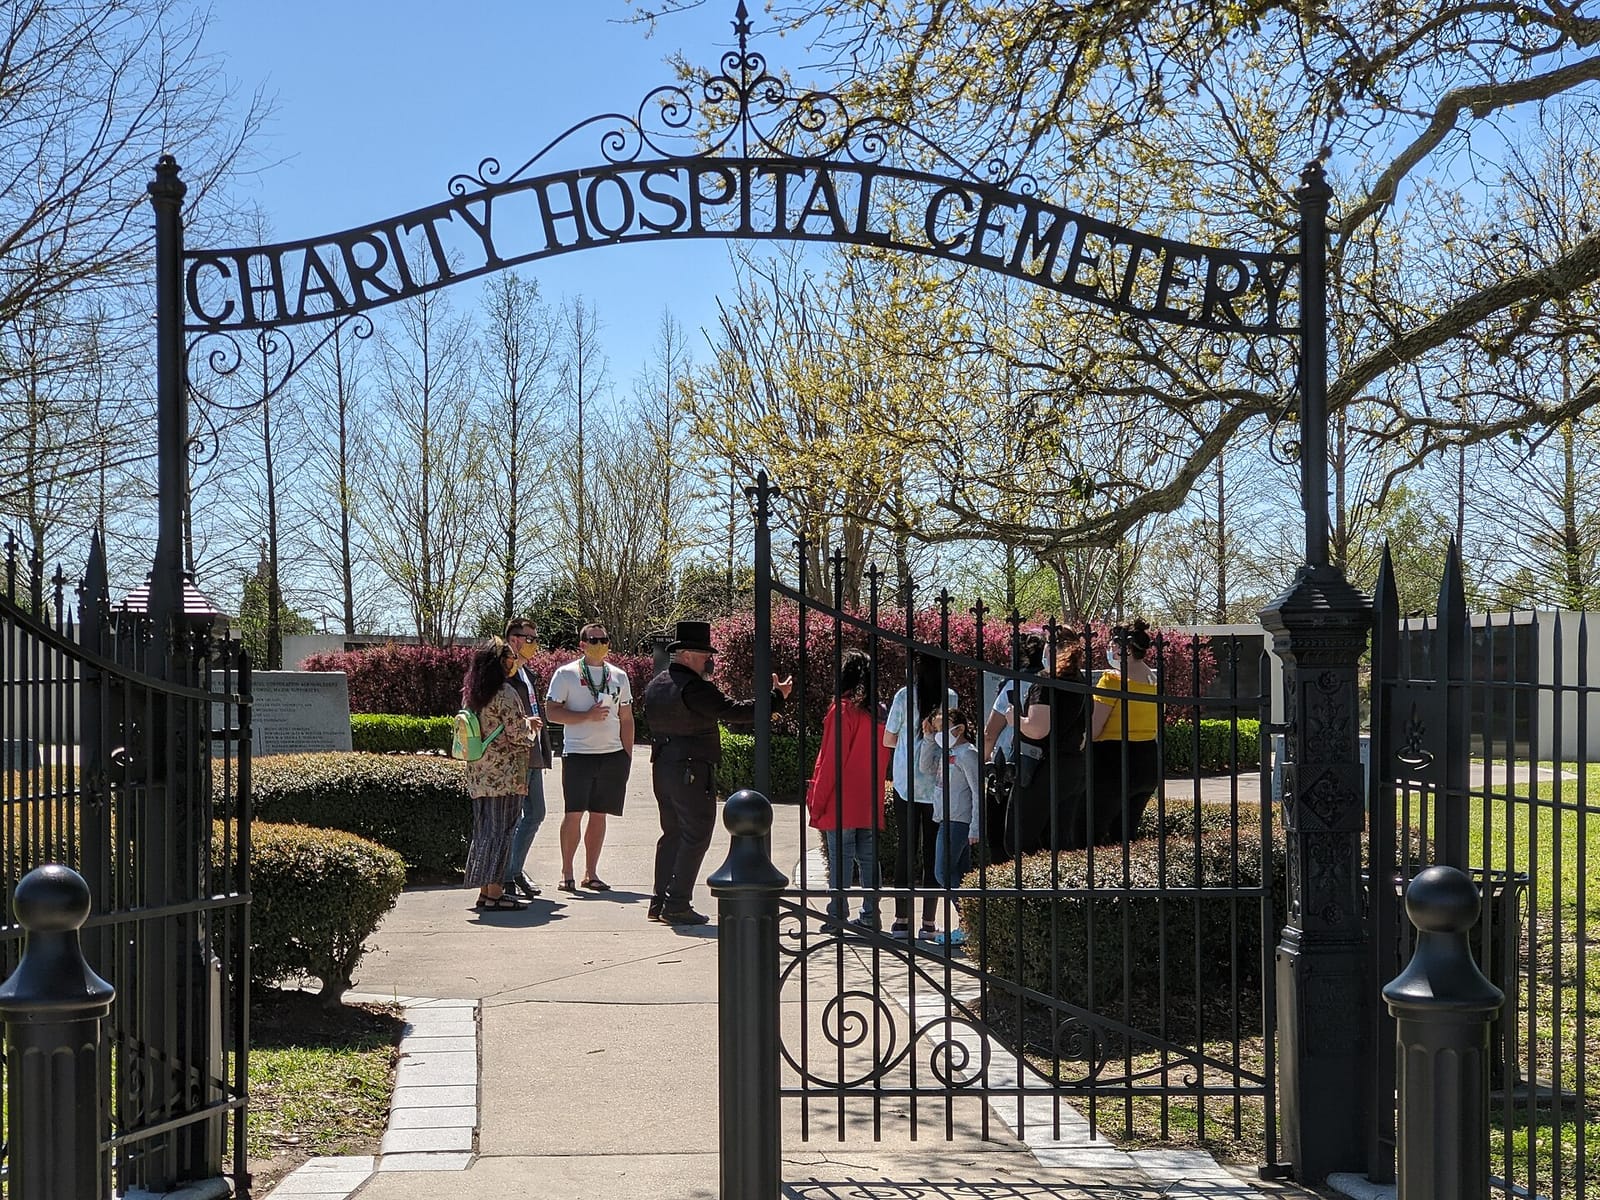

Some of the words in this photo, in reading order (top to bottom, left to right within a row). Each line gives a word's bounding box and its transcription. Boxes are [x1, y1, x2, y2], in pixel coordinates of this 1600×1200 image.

[187, 195, 504, 325] CHARITY
[535, 164, 891, 250] HOSPITAL
[924, 186, 1299, 328] CEMETERY
